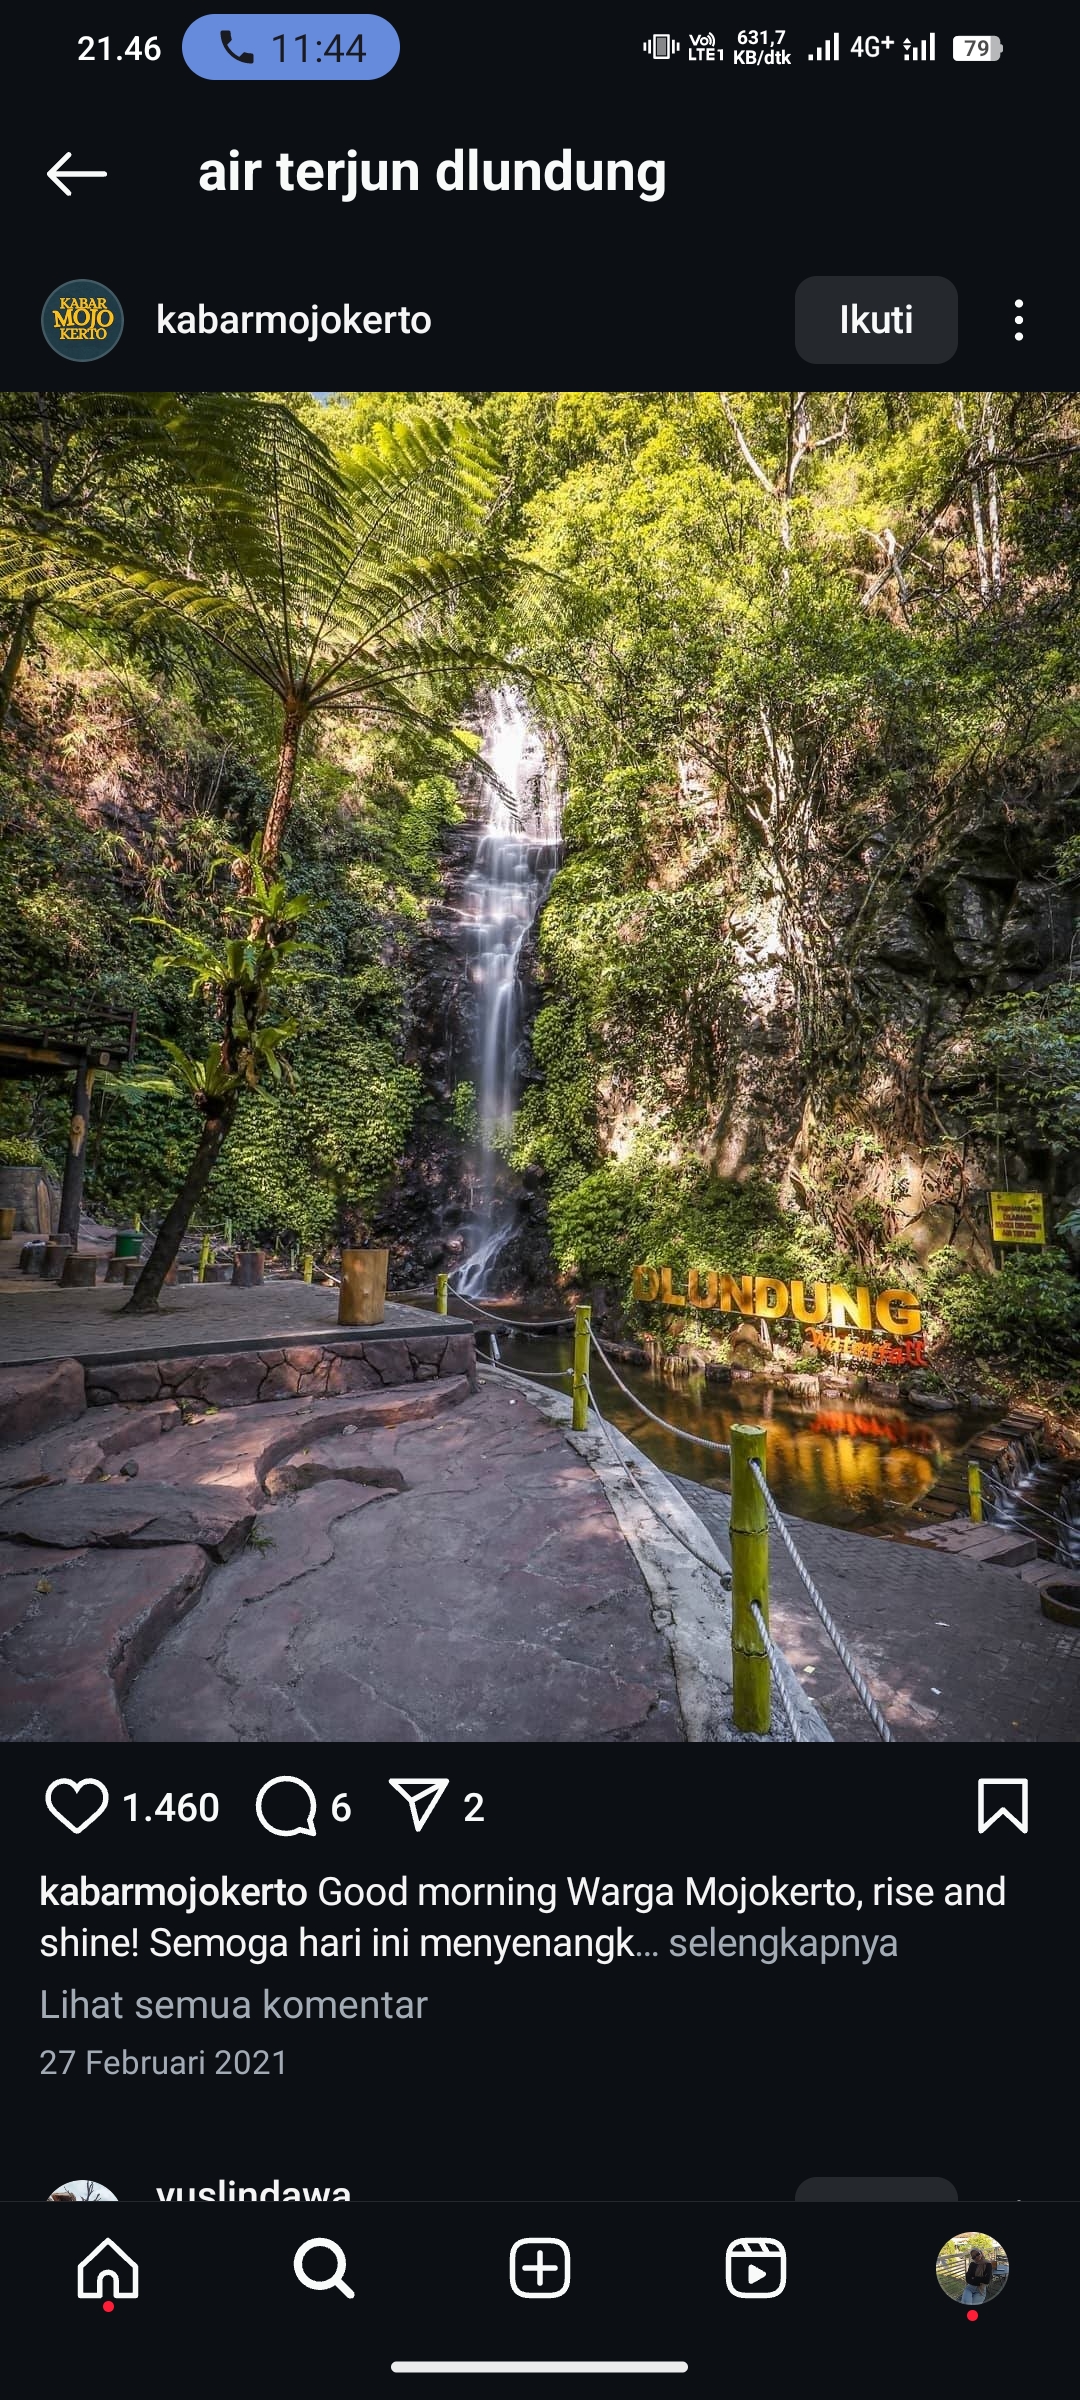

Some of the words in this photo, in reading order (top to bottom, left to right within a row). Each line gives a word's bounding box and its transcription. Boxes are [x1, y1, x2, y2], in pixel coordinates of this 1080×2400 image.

[78, 36, 161, 61] 21.46
[272, 34, 367, 62] 11:44
[738, 30, 785, 47] 631,7
[850, 36, 894, 57] 4G+
[964, 40, 989, 57] 79
[734, 49, 791, 66] KB/dtk
[199, 149, 262, 191] air
[276, 149, 418, 202] terjun
[436, 148, 665, 202] dlundung
[60, 297, 107, 309] KABAR
[52, 308, 114, 329] MOJO
[158, 303, 431, 342] kabarmojokerto
[842, 303, 912, 334] Ikuti
[60, 328, 107, 340] KERTO
[633, 1265, 921, 1335] DLUNDUNG
[124, 1793, 219, 1822] 1.460
[332, 1793, 351, 1822] 6
[464, 1793, 484, 1821] 2
[41, 1875, 307, 1914] kabarmojokerto
[319, 1875, 407, 1906] Good
[419, 1877, 556, 1913] morning
[567, 1877, 673, 1913] Warga
[687, 1875, 862, 1914] Mojokerto,
[874, 1877, 934, 1906] rise
[945, 1875, 1005, 1906] and
[41, 1926, 138, 1957] shine!
[150, 1928, 287, 1964] Semoga
[300, 1926, 360, 1957] hari
[373, 1928, 408, 1956] ini
[670, 1927, 897, 1964] selengkapnya
[42, 1989, 123, 2019] Lihat
[136, 1997, 250, 2019] semua
[265, 1989, 428, 2019] komentar
[40, 2050, 75, 2074] 27
[88, 2049, 204, 2074] Februari
[215, 2050, 283, 2074] 2021
